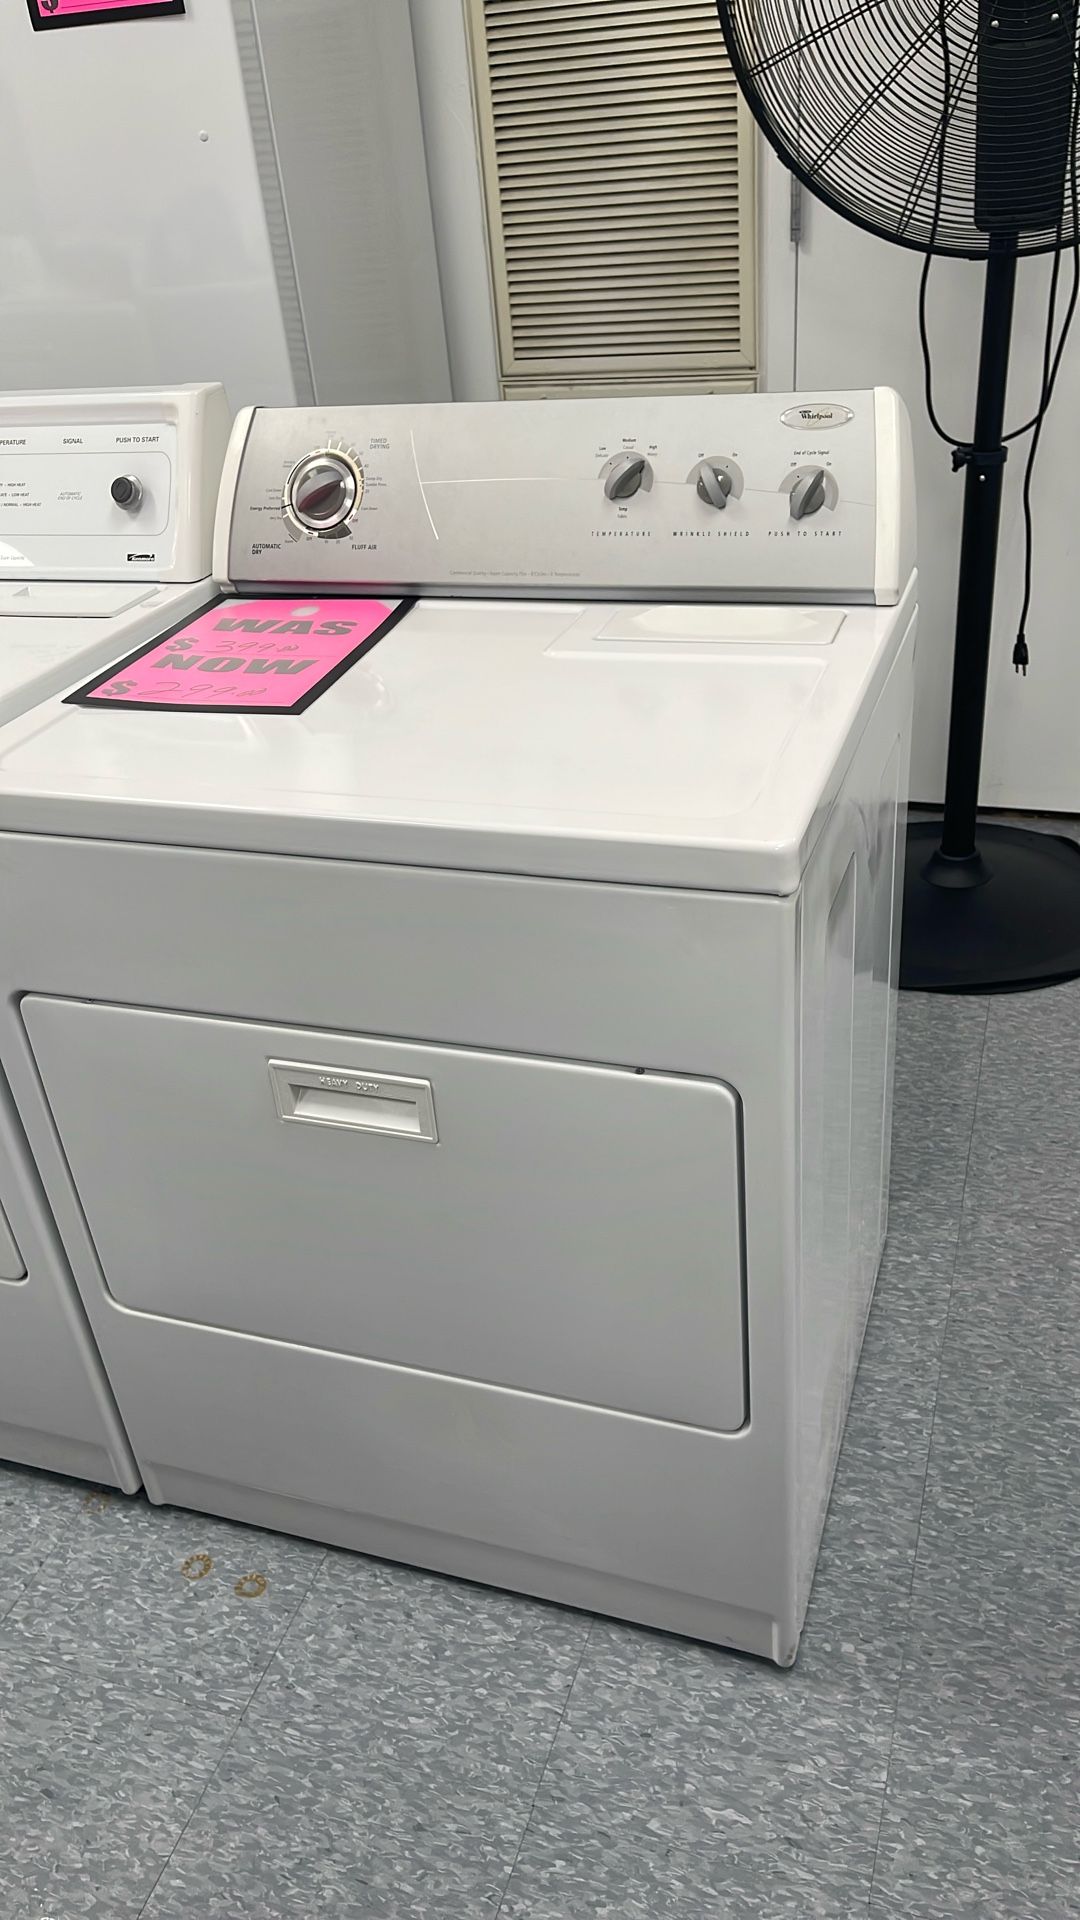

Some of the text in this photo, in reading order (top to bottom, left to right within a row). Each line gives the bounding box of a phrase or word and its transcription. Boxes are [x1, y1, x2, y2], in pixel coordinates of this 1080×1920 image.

[800, 411, 833, 420] Whirlpool
[212, 617, 358, 635] WAS
[165, 637, 200, 652] $
[150, 653, 319, 675] NOW
[101, 680, 138, 697] $
[318, 1075, 380, 1091] HEAVY DUTY
